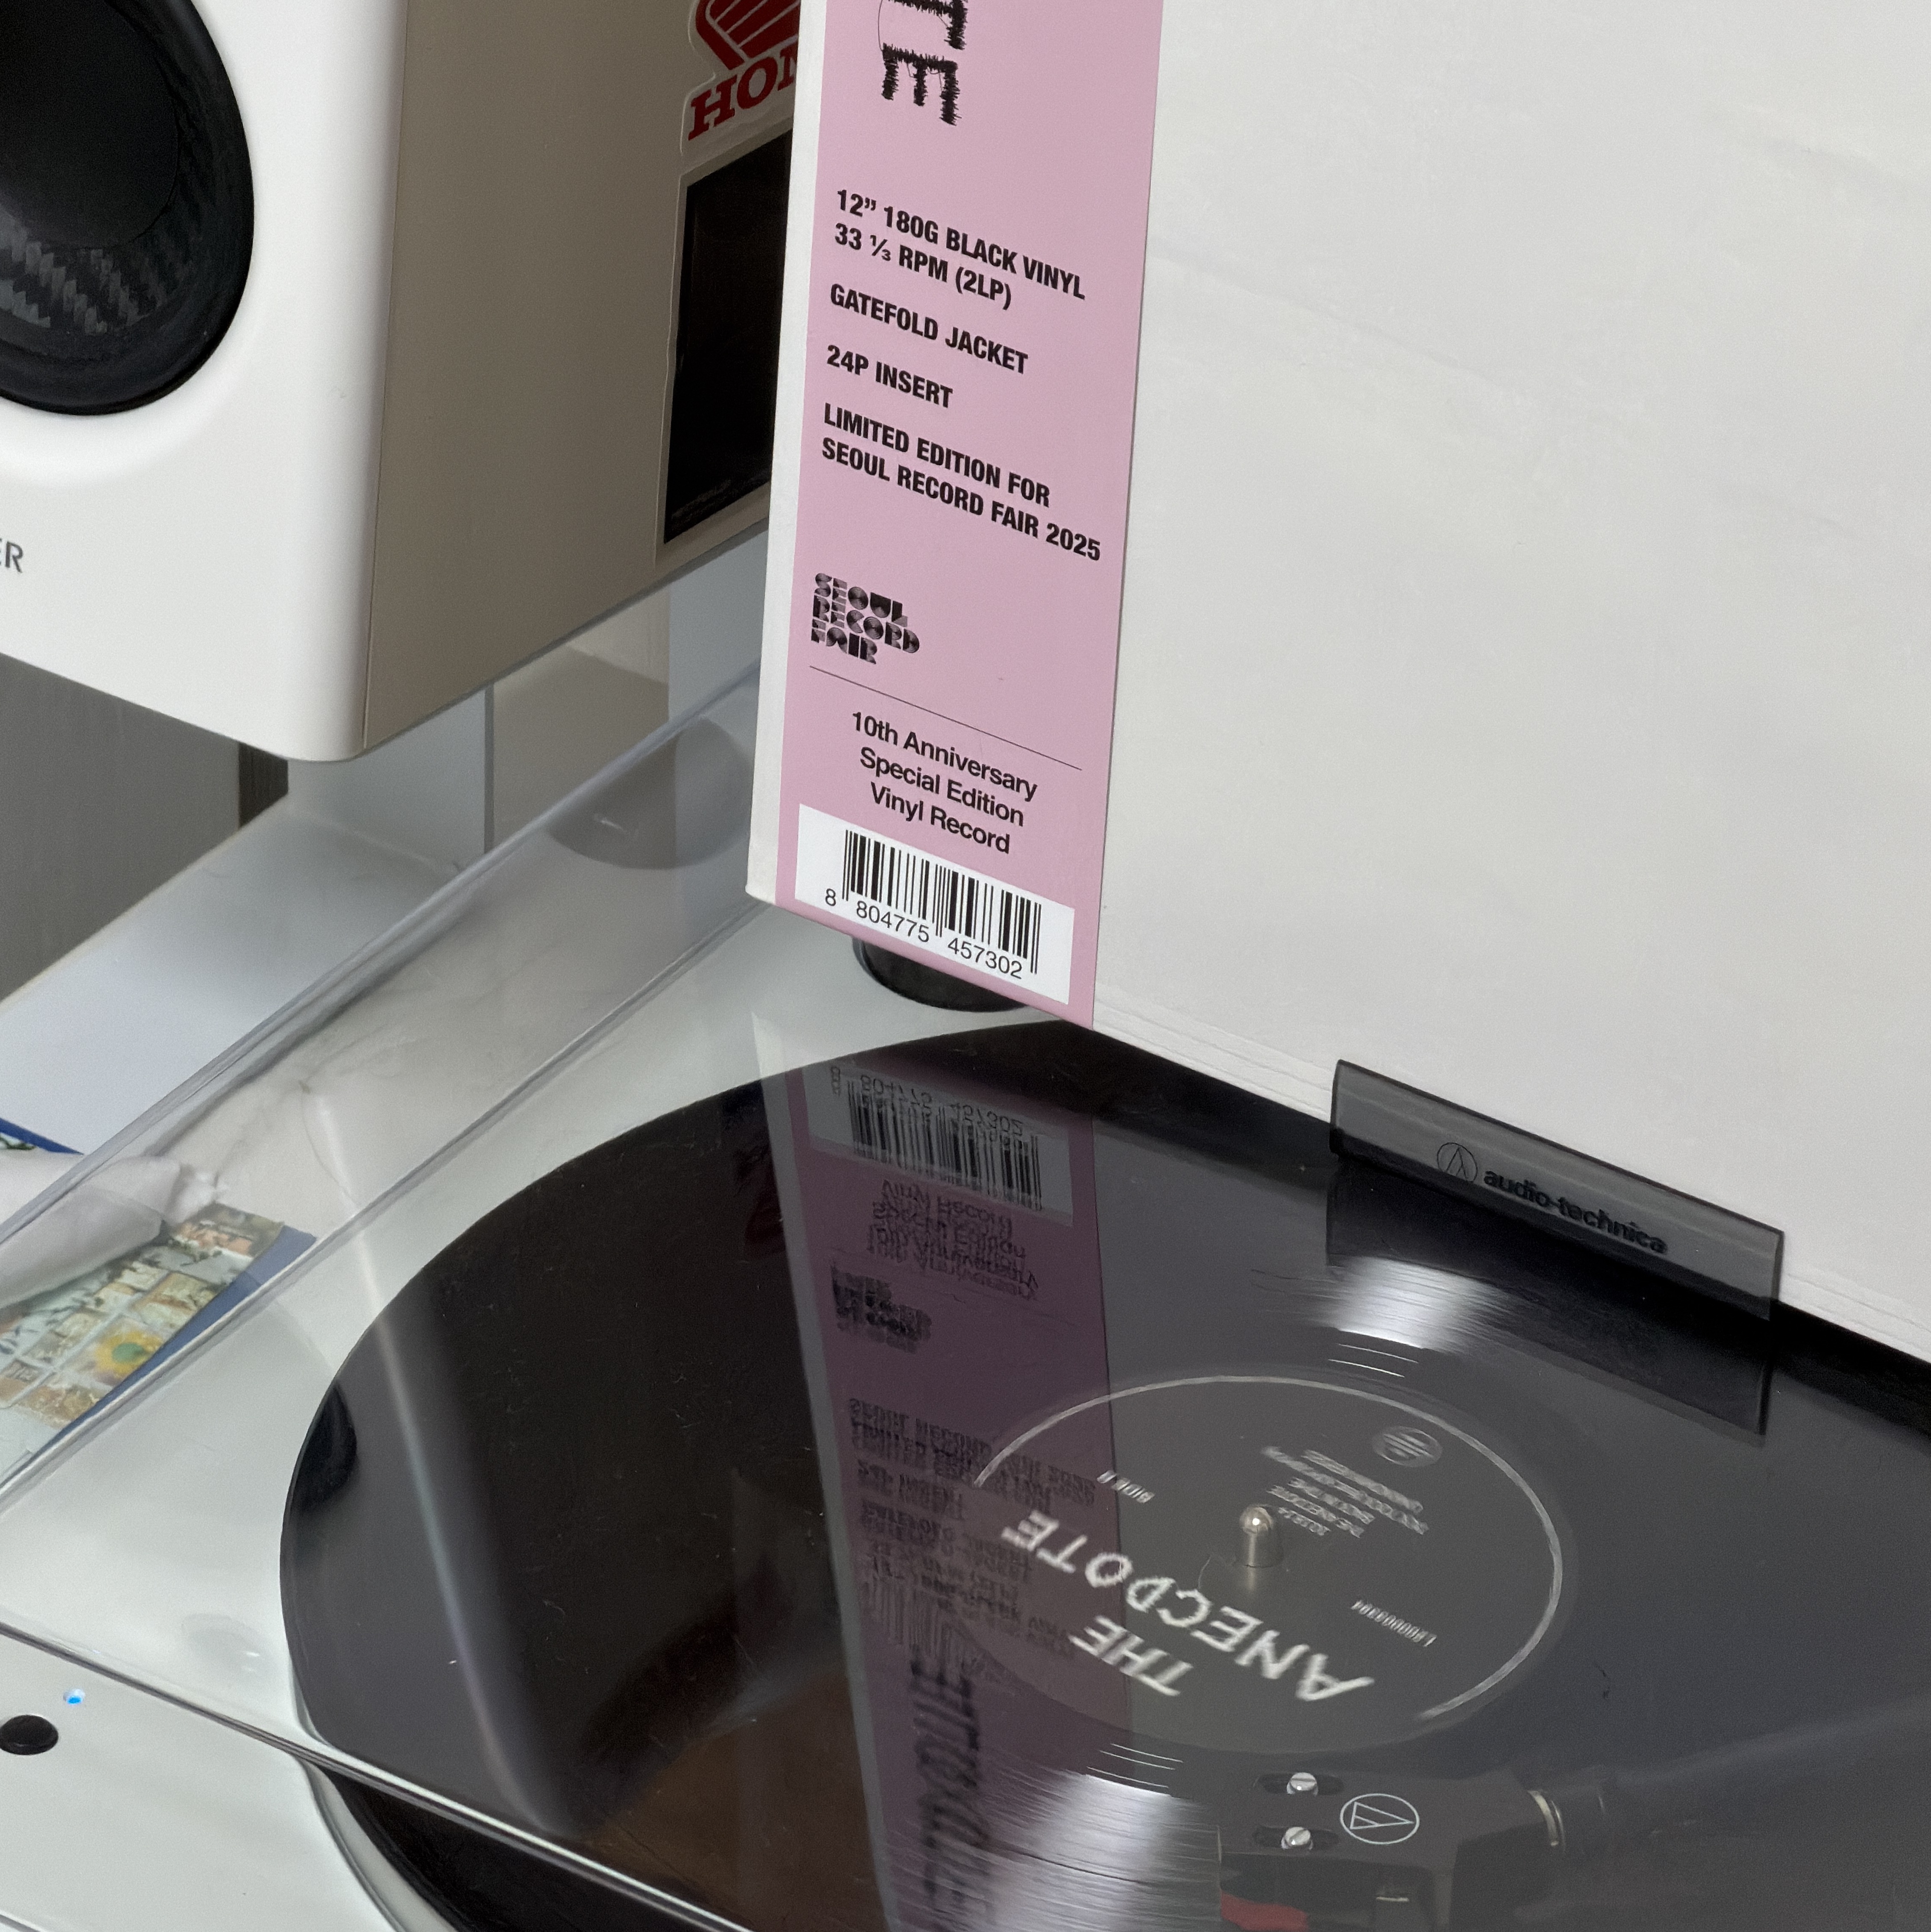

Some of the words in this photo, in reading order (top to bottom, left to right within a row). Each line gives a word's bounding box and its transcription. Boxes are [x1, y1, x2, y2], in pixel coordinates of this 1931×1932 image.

[835, 223, 861, 250] 33
[899, 245, 948, 282] RPM
[955, 267, 1011, 310] (2LP)
[884, 207, 938, 244] 180G
[946, 227, 1017, 274] BLACK
[1023, 255, 1085, 300] VINYL
[831, 284, 938, 340] GATEFOLD
[945, 327, 1028, 374] JACKET
[827, 345, 869, 375] 24P
[876, 362, 953, 408] INSERT
[823, 438, 889, 481] SEOUL
[898, 465, 983, 515] RECORD
[992, 501, 1039, 538] FAIR
[1046, 523, 1100, 560] 2025
[824, 403, 909, 452] LIMITED
[917, 438, 1000, 488] EDITION
[1008, 472, 1050, 508] FOR
[812, 594, 920, 654] RECORD
[814, 573, 908, 627] SEOUL
[853, 712, 898, 746] 10th
[903, 732, 1037, 802] Anniversary
[861, 747, 940, 794] Special
[947, 779, 1023, 827] Edition
[871, 782, 924, 821] Vinyl
[931, 806, 1010, 854] Record
[825, 888, 836, 907] 8
[857, 901, 929, 942] 804775
[948, 938, 1021, 979] 457302
[1483, 1170, 1667, 1255] audio-technica
[1001, 1510, 1374, 1701] ANECDOTE
[1067, 1616, 1192, 1696] THE
